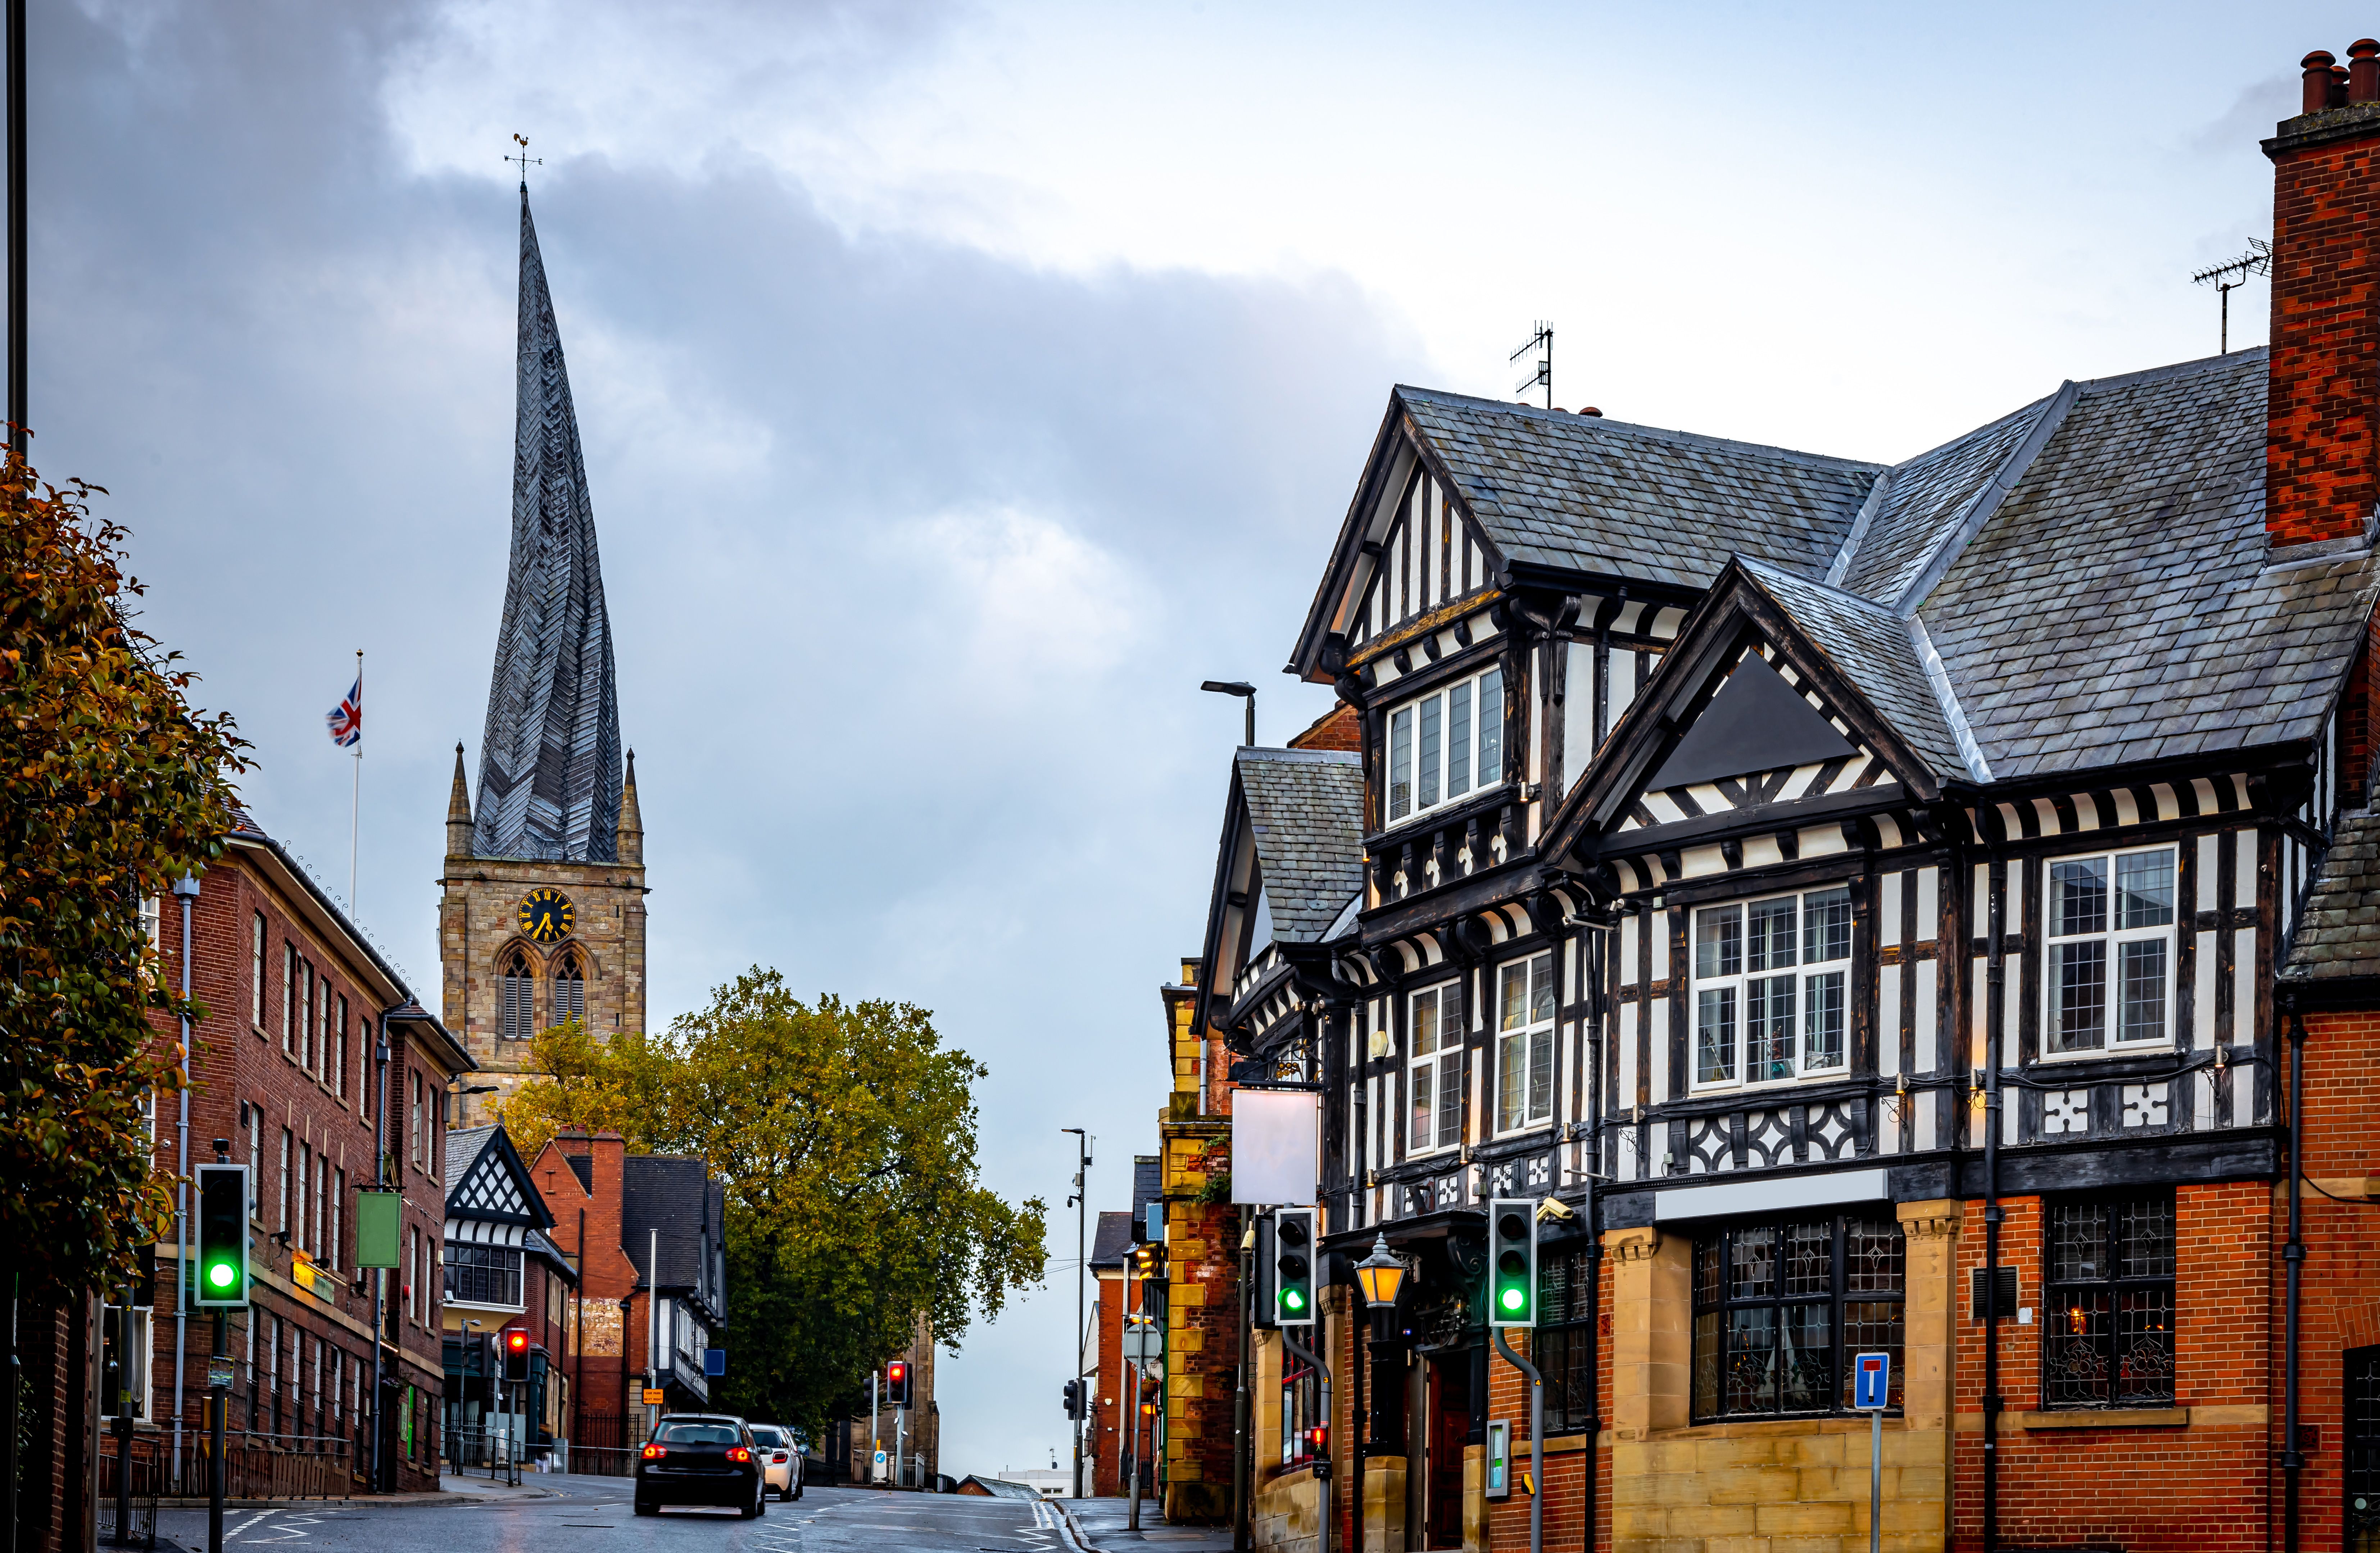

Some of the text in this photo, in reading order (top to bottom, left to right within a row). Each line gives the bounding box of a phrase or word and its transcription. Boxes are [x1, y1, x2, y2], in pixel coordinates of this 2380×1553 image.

[532, 893, 541, 902] XI
[544, 932, 549, 941] VI
[554, 931, 561, 939] V
